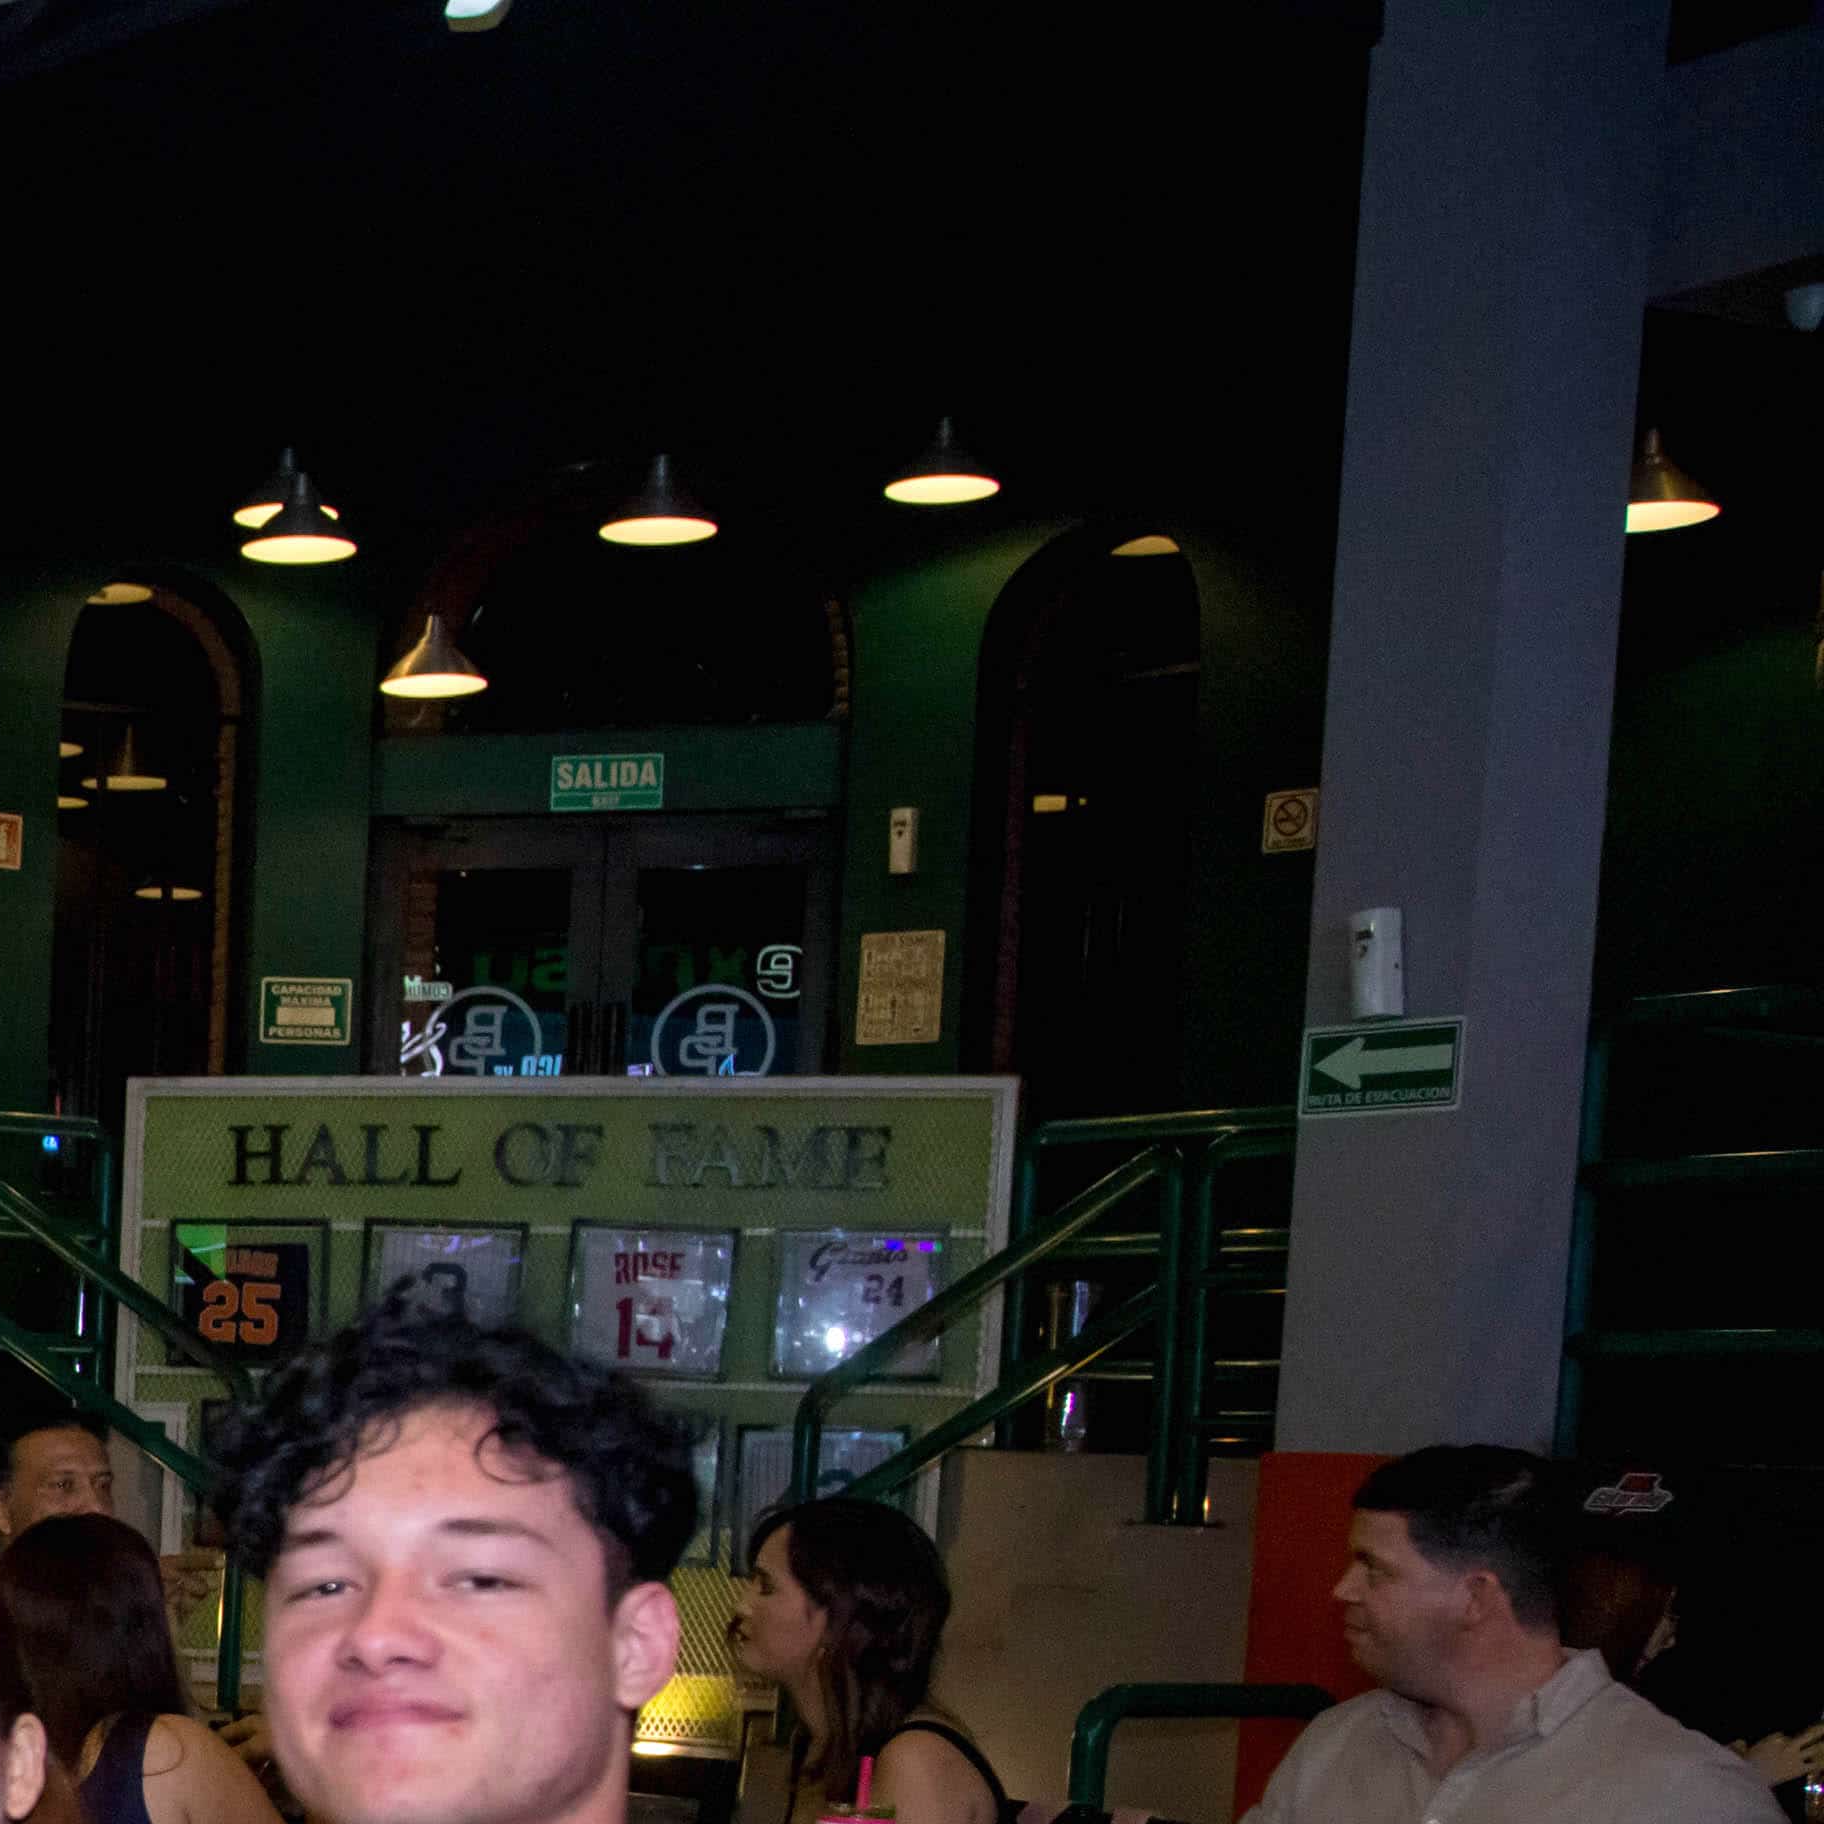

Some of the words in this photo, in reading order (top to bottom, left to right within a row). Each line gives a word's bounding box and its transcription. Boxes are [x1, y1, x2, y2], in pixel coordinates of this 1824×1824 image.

[557, 760, 657, 790] SALIDA
[271, 983, 343, 996] CAPACIDAD
[268, 1026, 342, 1040] PERSONAS
[1345, 1091, 1363, 1105] DE
[226, 1123, 462, 1187] HALL
[494, 1121, 605, 1188] OF
[648, 1123, 893, 1189] FAME
[861, 1274, 905, 1307] 24
[197, 1279, 284, 1346] 25
